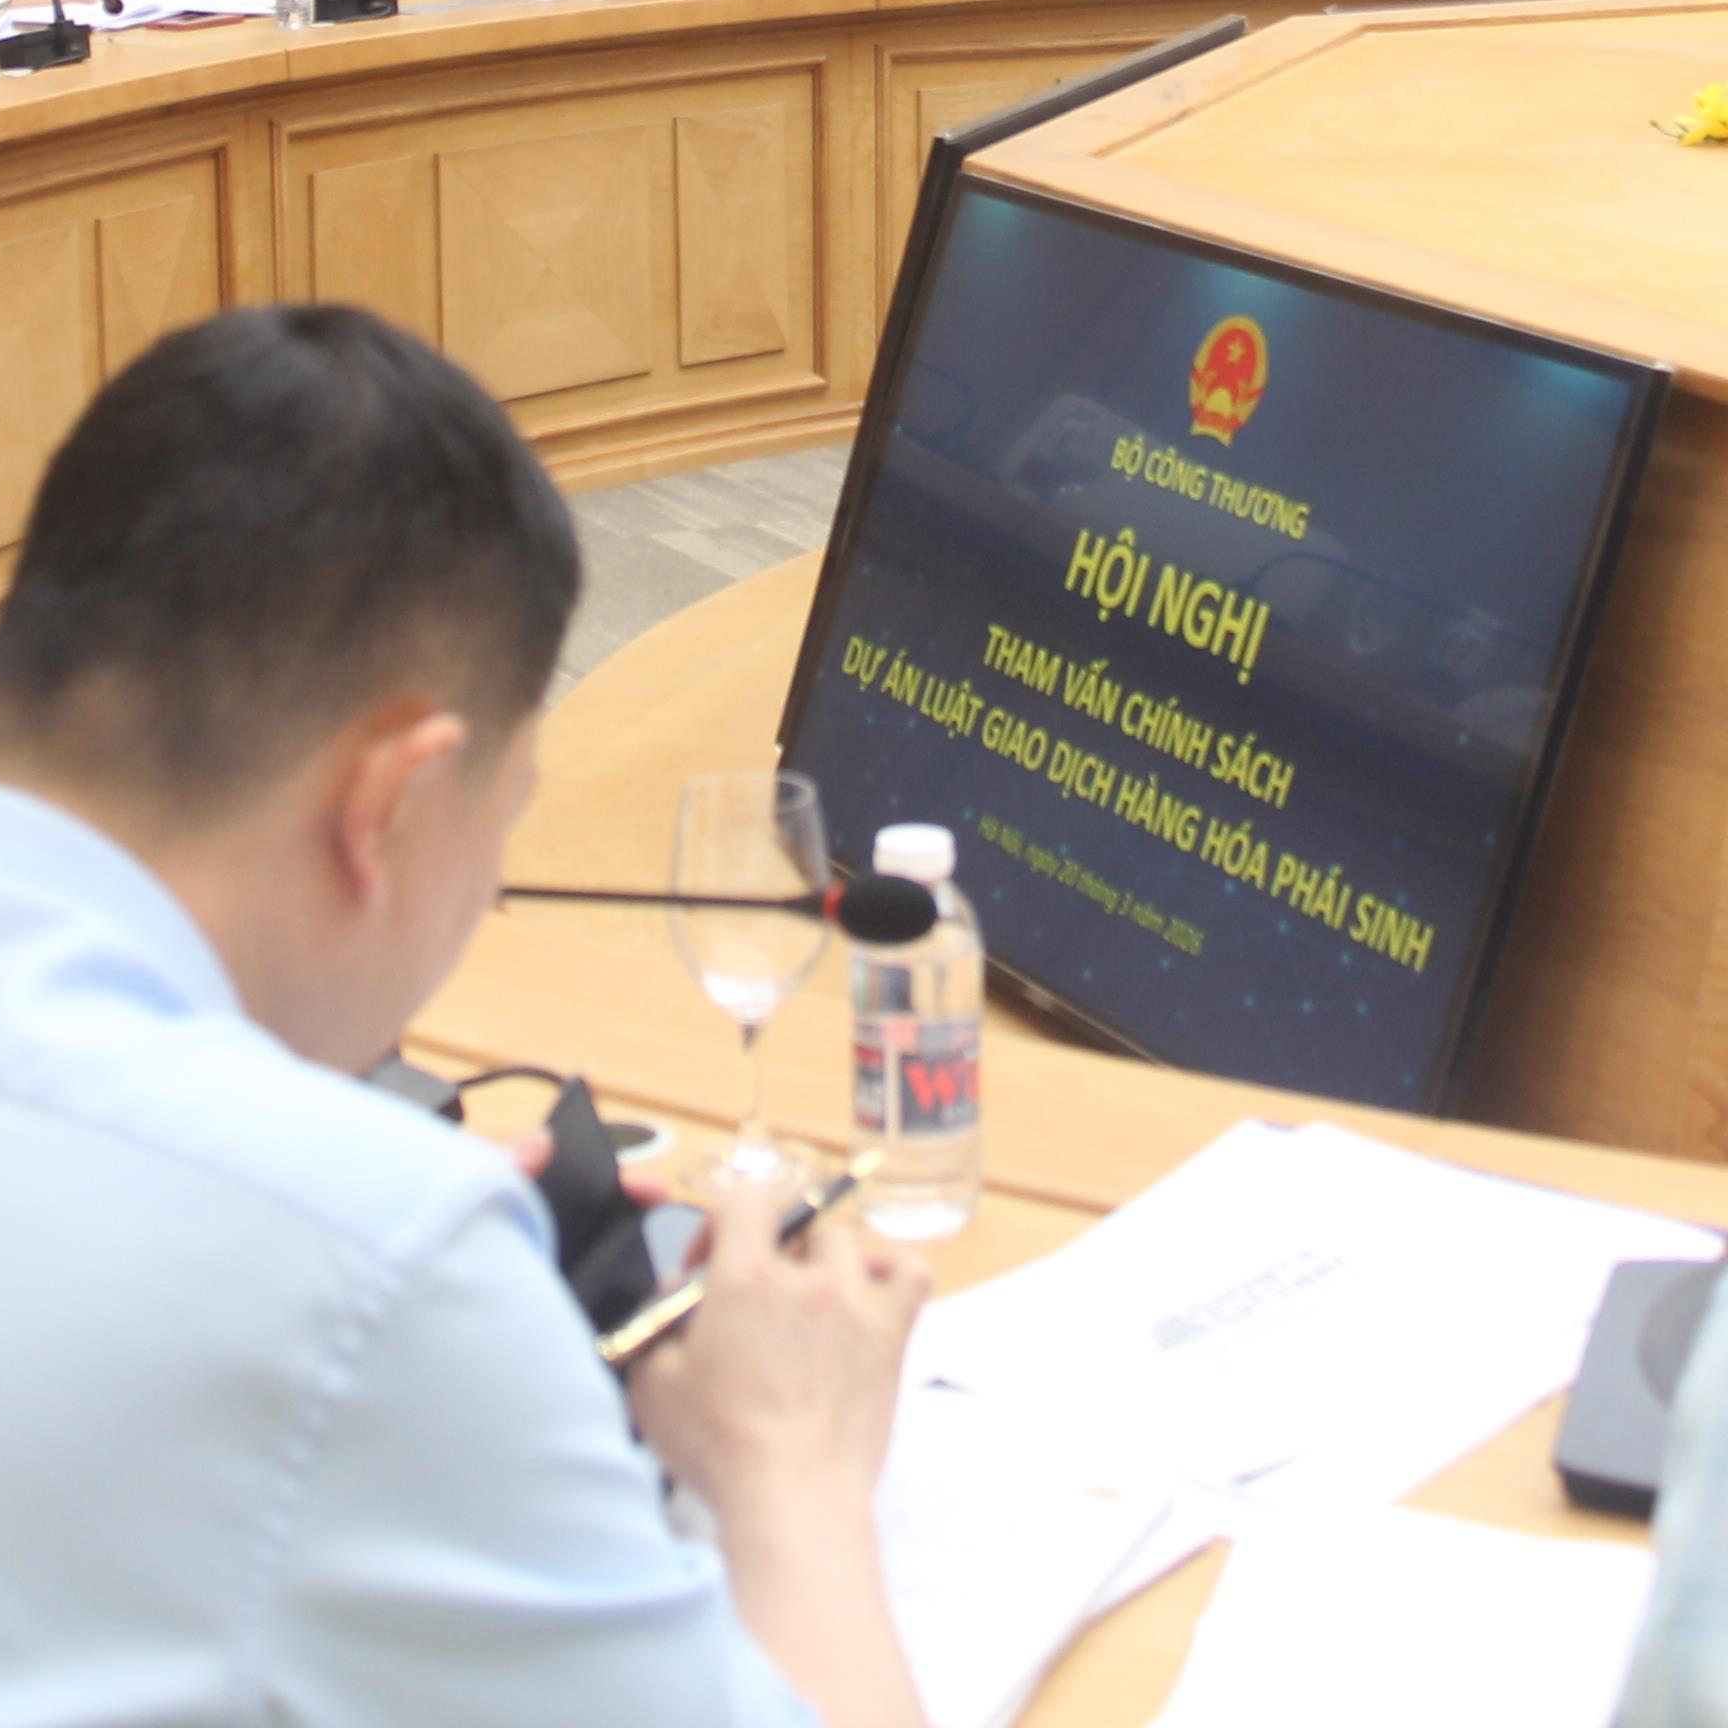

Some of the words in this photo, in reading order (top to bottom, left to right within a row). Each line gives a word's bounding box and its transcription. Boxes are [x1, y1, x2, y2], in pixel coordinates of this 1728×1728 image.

[1064, 527, 1151, 621] HỘI
[1149, 565, 1270, 685] NGHỊ
[843, 638, 884, 689] DỰ
[883, 650, 922, 705] ÁN
[920, 678, 983, 738] LUẬT
[981, 710, 1048, 772] GIAO
[1046, 742, 1116, 806] DỊCH
[1116, 775, 1201, 853] HÀNG
[1201, 822, 1270, 889] HÓA
[1271, 853, 1352, 929] PHÁI
[1349, 894, 1434, 971] SINH
[984, 624, 1063, 691] THAM
[1064, 659, 1122, 722] VẤN
[1122, 692, 1215, 767] CHÍNH
[1212, 732, 1296, 807] SÁCH
